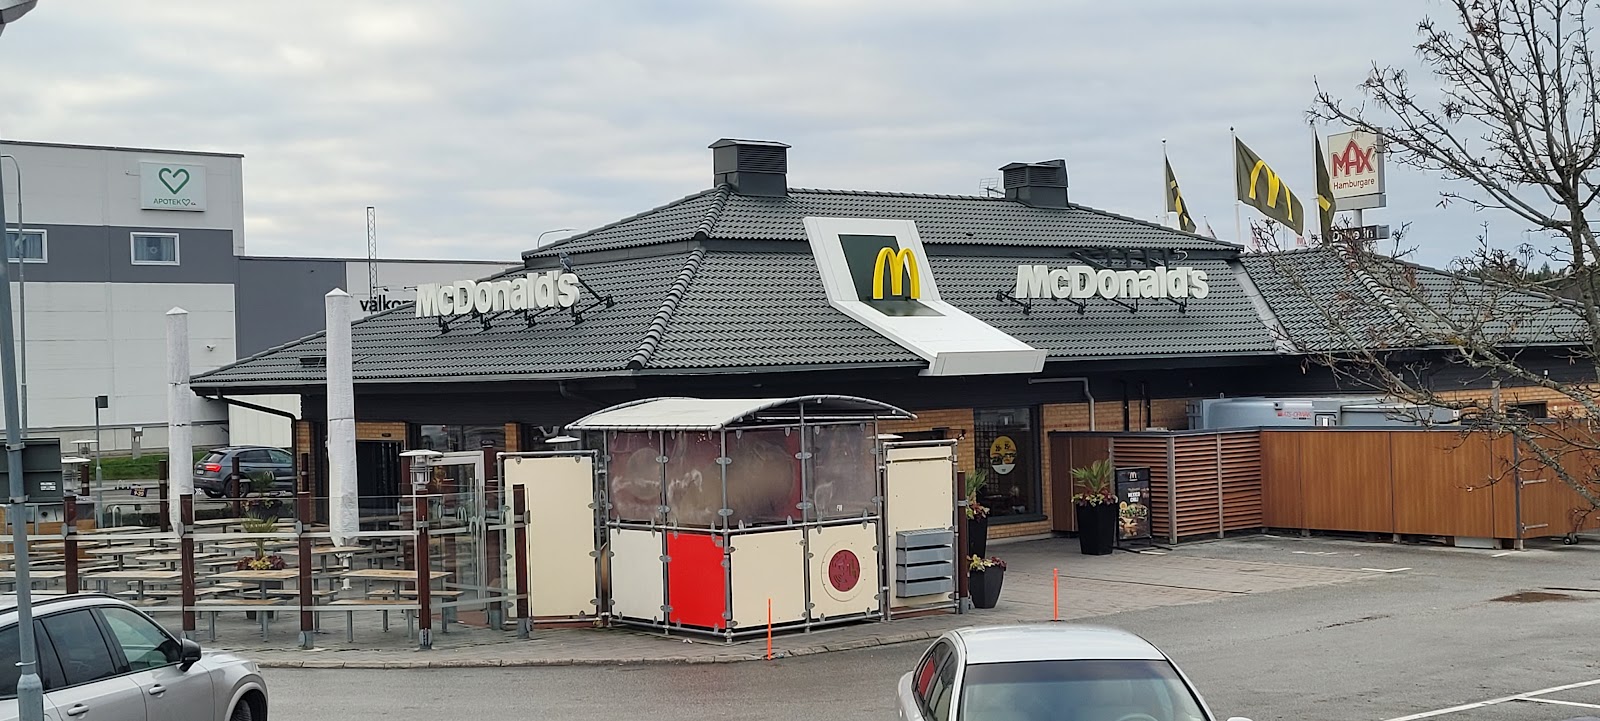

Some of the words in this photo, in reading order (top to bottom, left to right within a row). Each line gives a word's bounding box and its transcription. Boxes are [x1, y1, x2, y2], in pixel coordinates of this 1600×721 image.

[1332, 138, 1376, 178] MAX
[1333, 178, 1375, 190] Hamburgare
[415, 270, 580, 318] McDonald's
[1015, 265, 1209, 299] McDonald's
